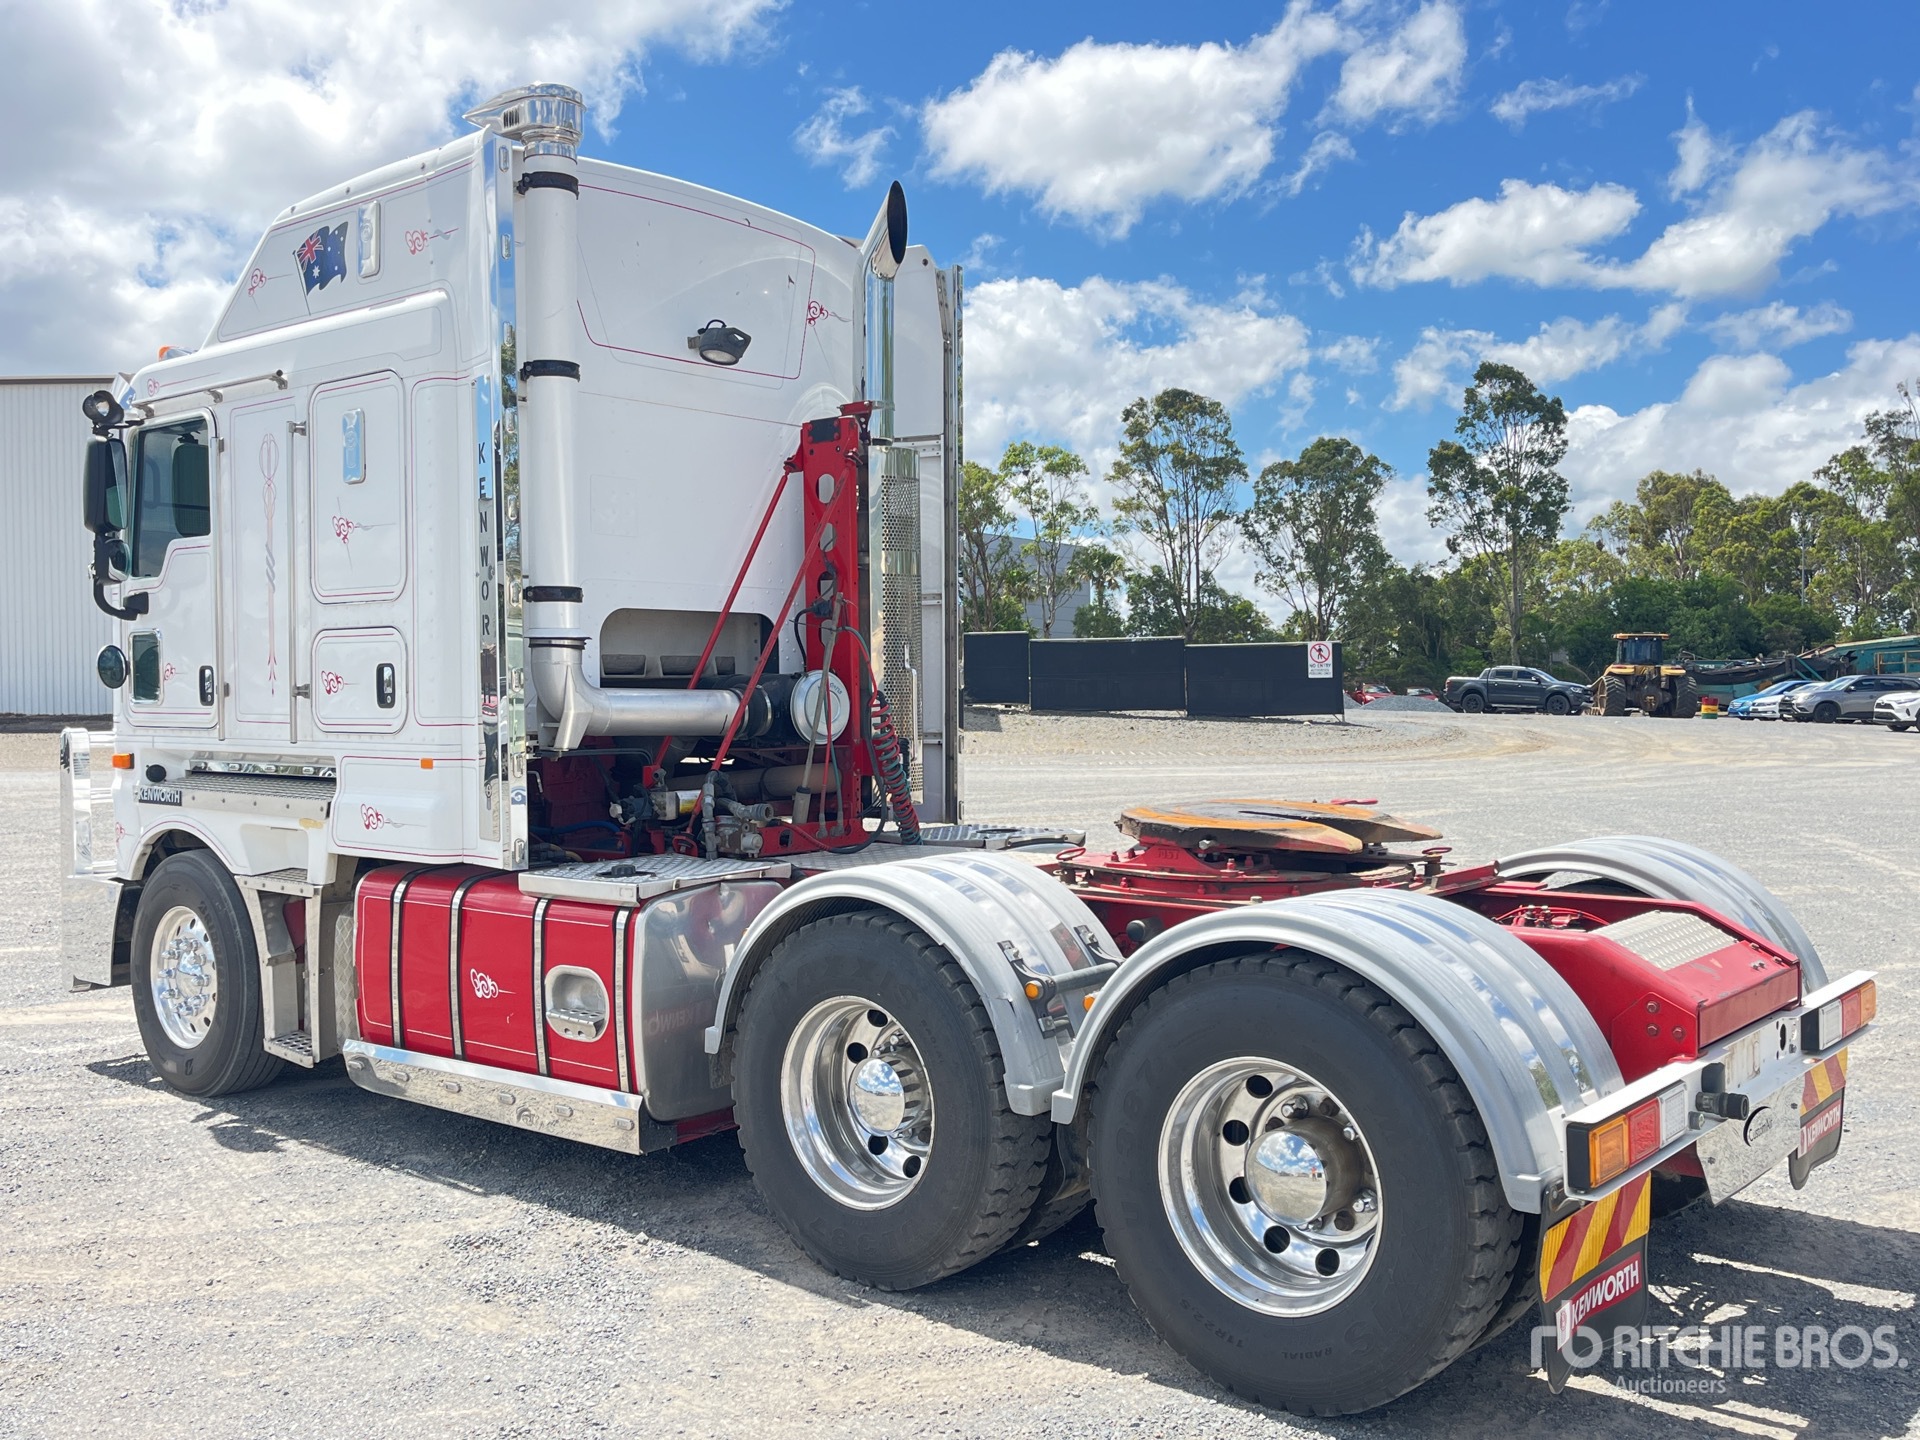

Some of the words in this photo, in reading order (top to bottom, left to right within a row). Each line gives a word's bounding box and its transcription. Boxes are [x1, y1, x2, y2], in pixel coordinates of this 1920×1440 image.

[139, 788, 180, 803] KENWORTH
[1807, 1104, 1840, 1147] KENWORTH
[1572, 1260, 1639, 1329] KENWORTH
[1281, 1347, 1332, 1361] RADIAL
